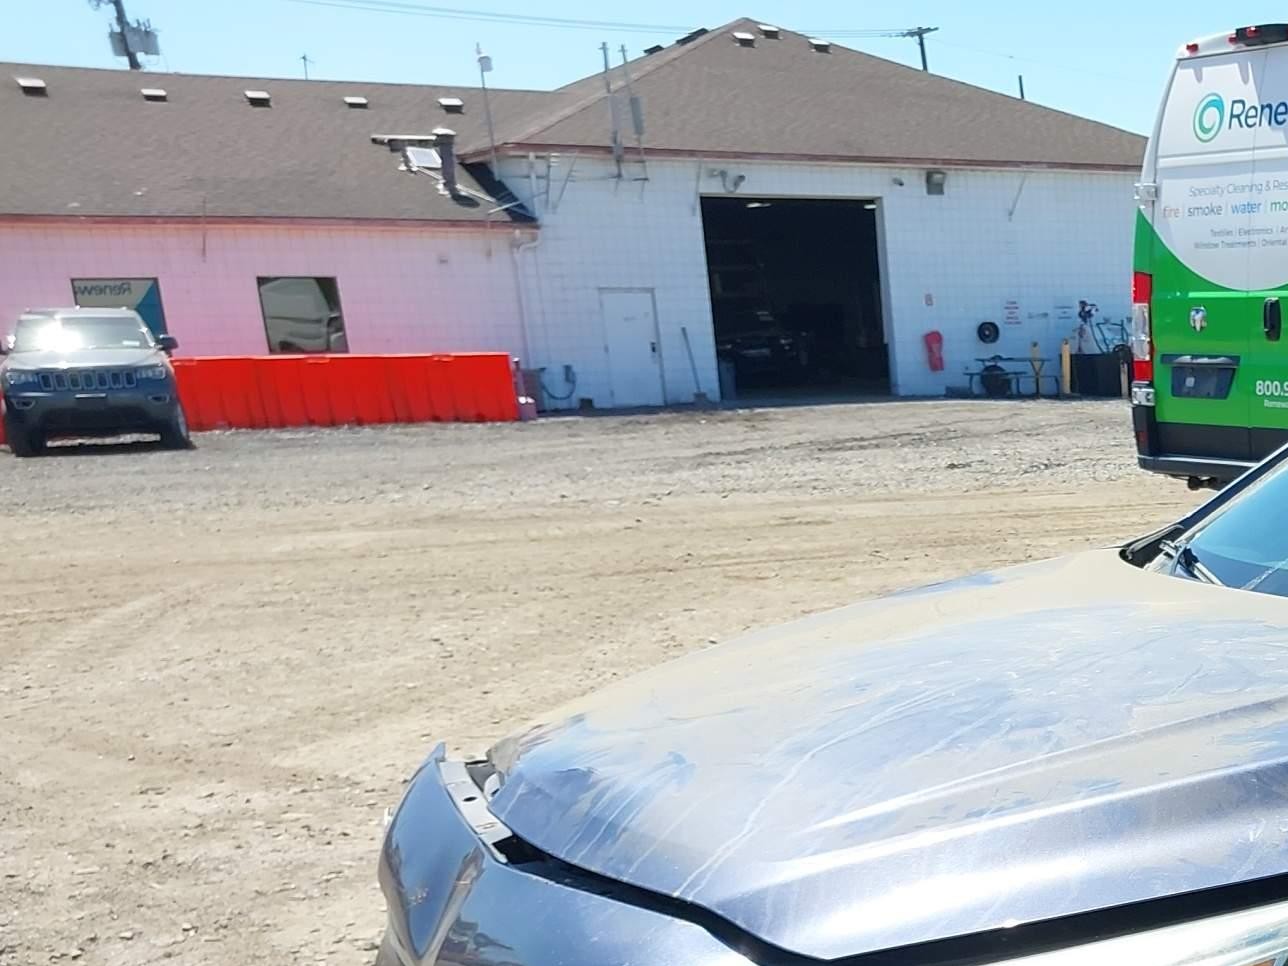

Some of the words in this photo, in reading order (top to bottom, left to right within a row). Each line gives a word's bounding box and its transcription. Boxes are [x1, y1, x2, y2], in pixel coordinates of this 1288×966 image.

[1226, 180, 1263, 196] Cleaning
[1162, 205, 1181, 218] fire
[1187, 202, 1223, 217] smoke
[1231, 201, 1262, 214] water
